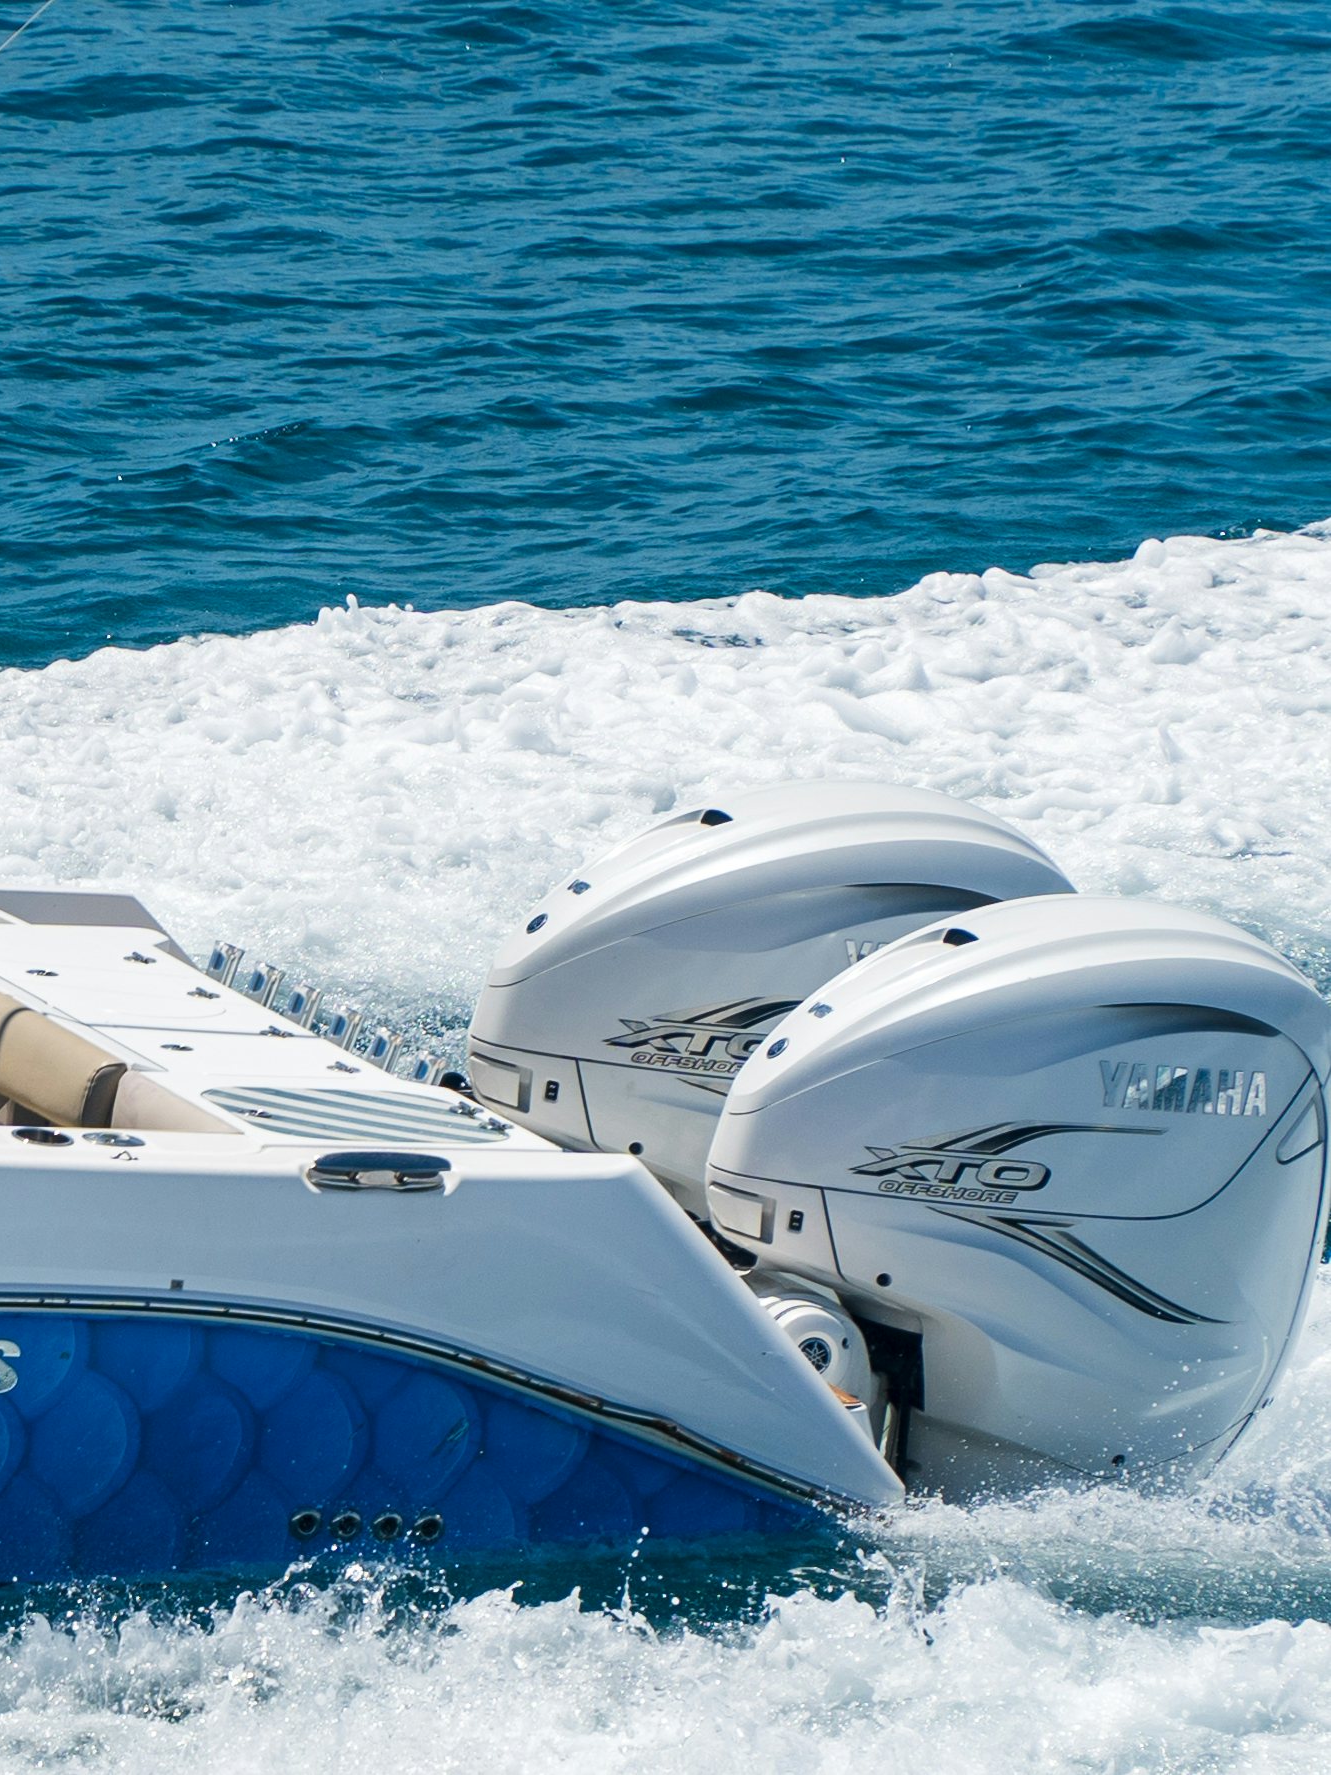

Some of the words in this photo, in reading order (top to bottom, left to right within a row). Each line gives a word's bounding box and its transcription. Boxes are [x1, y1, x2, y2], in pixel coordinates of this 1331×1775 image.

[1099, 1060, 1267, 1117] YAMAHA
[848, 1146, 1052, 1191] XTO
[878, 1179, 1020, 1204] OFFSHORE
